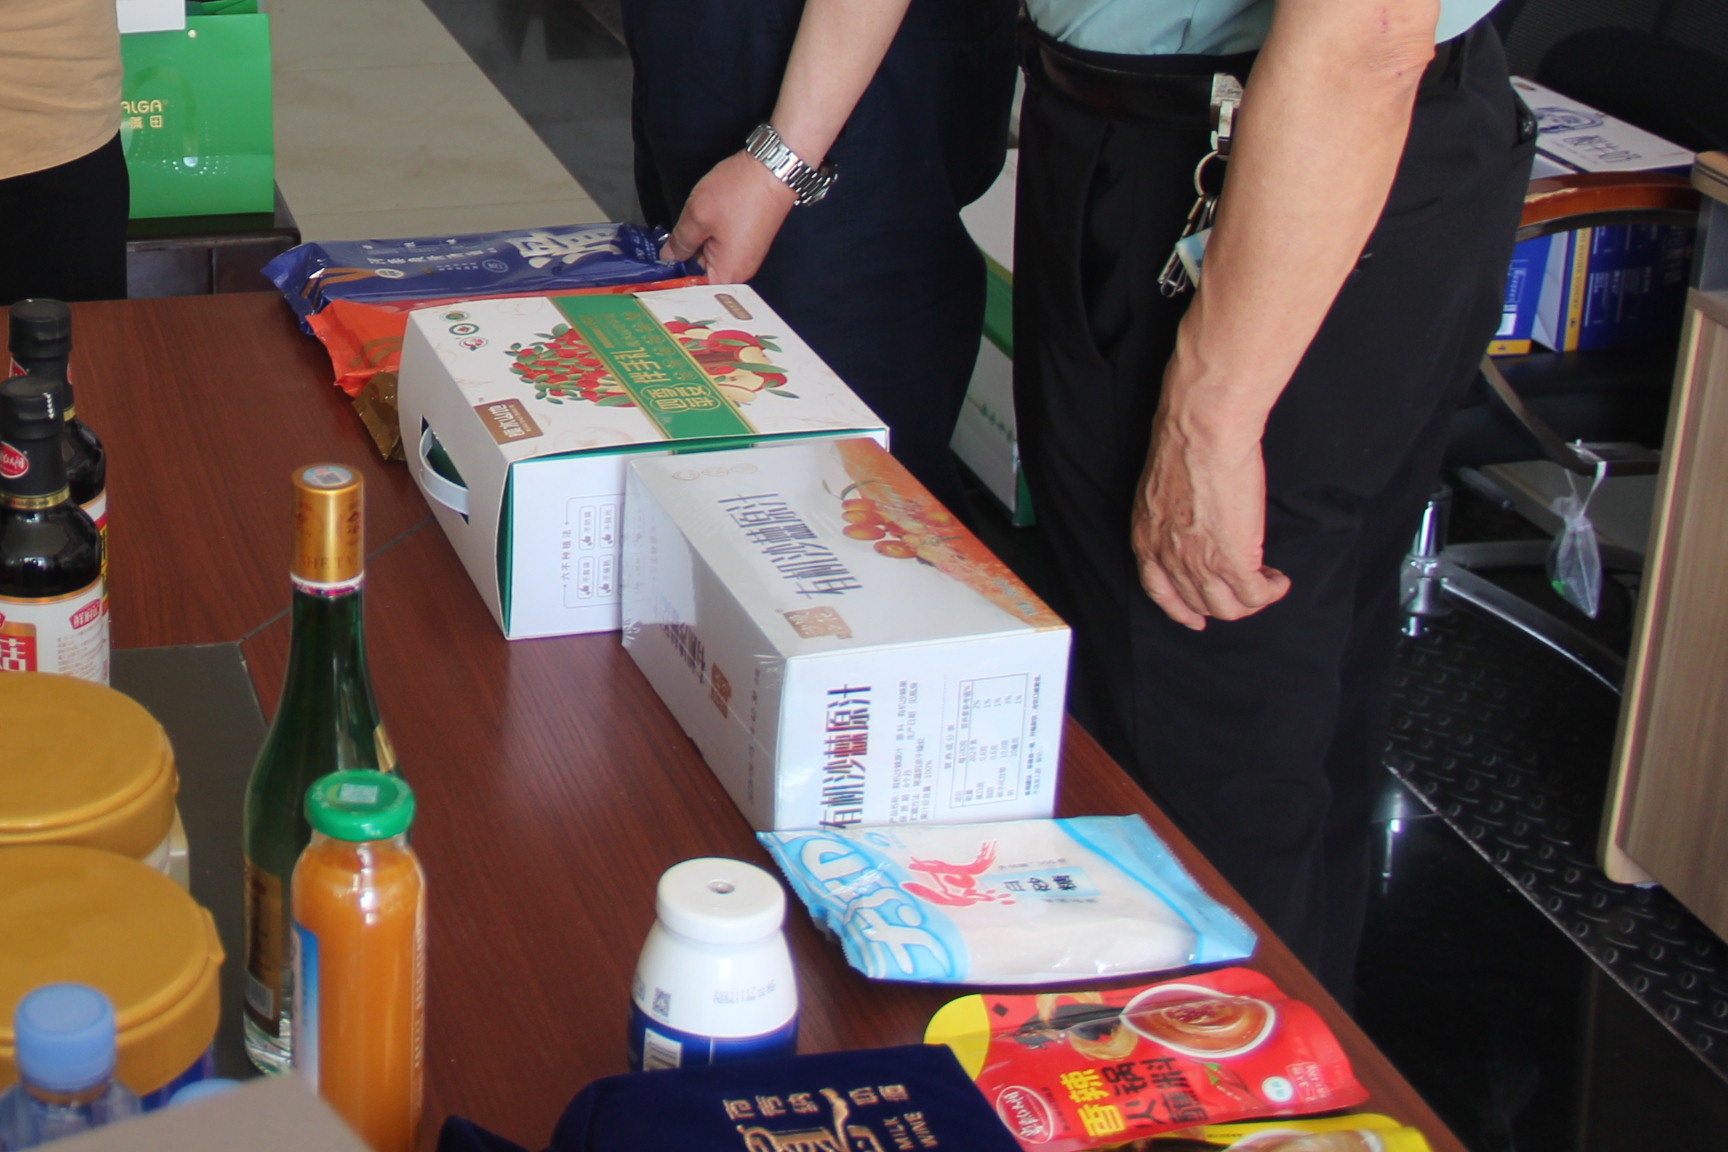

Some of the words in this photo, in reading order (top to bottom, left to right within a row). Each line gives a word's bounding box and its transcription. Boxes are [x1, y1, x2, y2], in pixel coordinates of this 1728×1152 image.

[1060, 1068, 1126, 1137] 香辣
[883, 1116, 914, 1151] MILK
[903, 1111, 939, 1148] WINE
